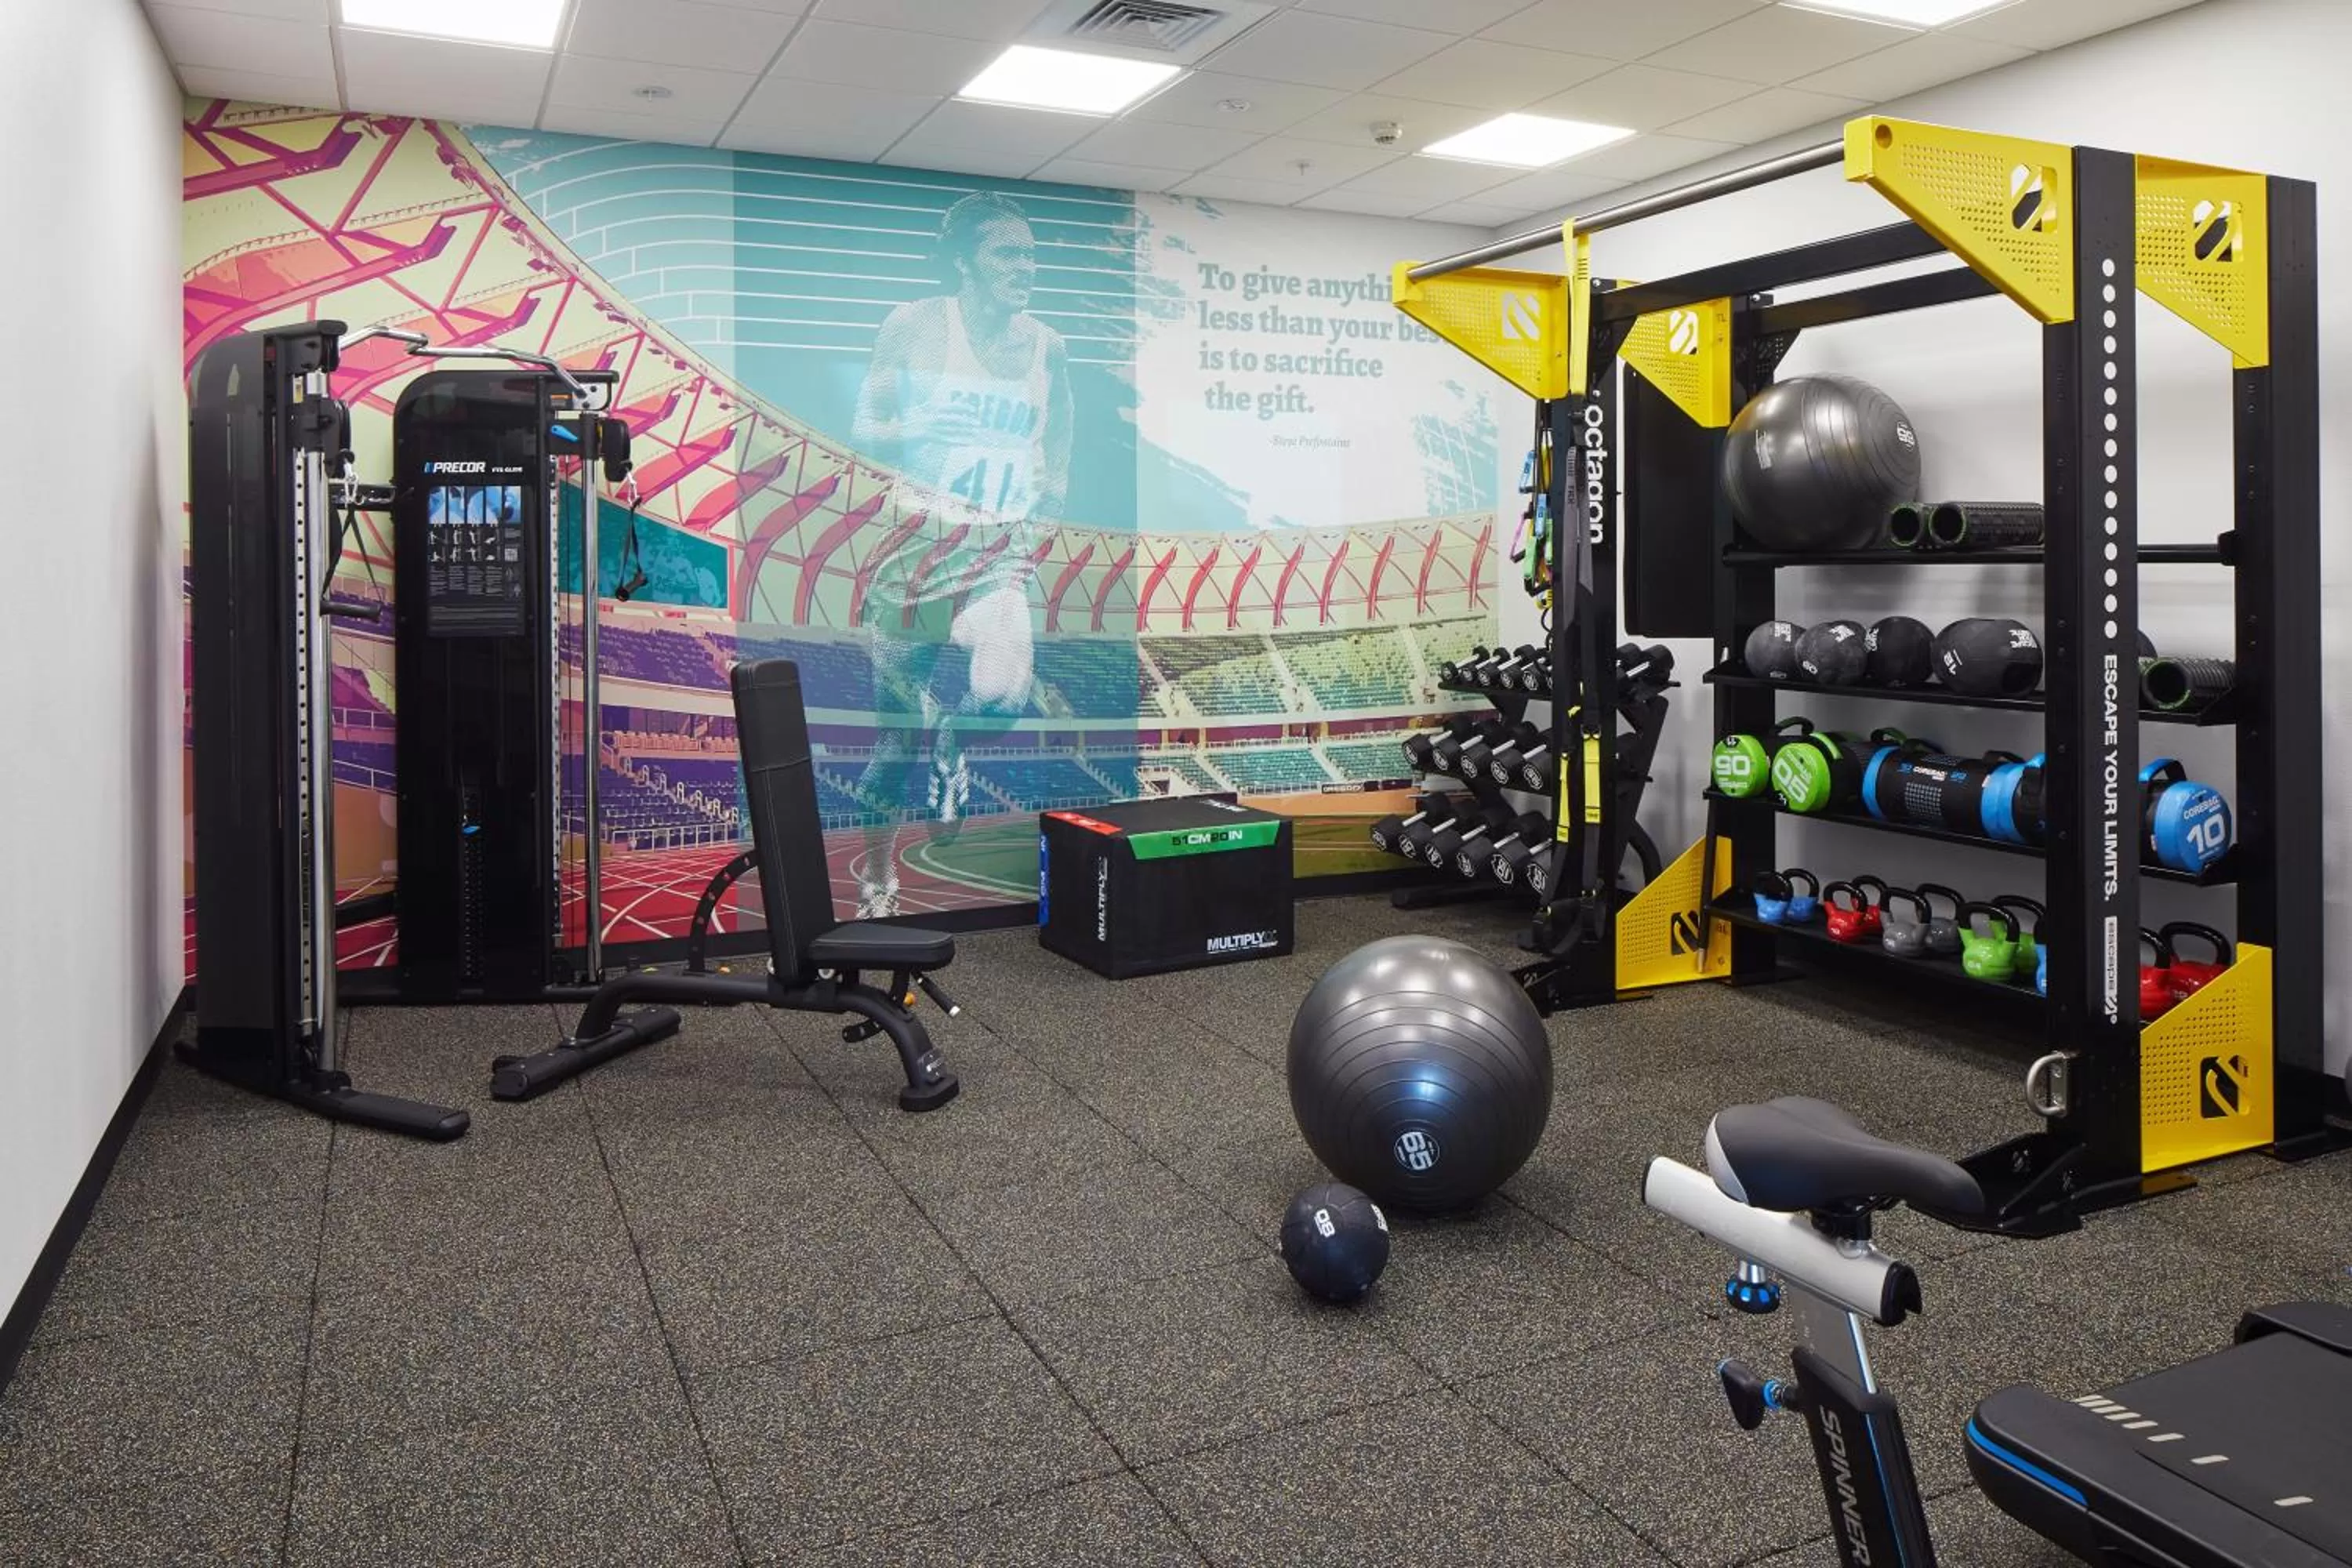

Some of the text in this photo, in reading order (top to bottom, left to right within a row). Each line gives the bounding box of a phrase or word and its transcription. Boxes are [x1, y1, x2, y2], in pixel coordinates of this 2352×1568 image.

[1198, 263, 1393, 307] To give anythi
[1198, 300, 1444, 344] less than your bes
[1198, 339, 1384, 379] is to sacrifice
[1204, 381, 1315, 420] the gift.
[432, 461, 486, 474] PRECOR
[2103, 654, 2118, 901] ESCAPE YOUR LIMITS.
[2186, 813, 2226, 854] 10
[1098, 870, 1106, 942] MULTIPLY
[1207, 931, 1265, 952] MULTIPLY
[1401, 1131, 1433, 1171] 65
[1819, 1404, 1872, 1567] SPINNER
